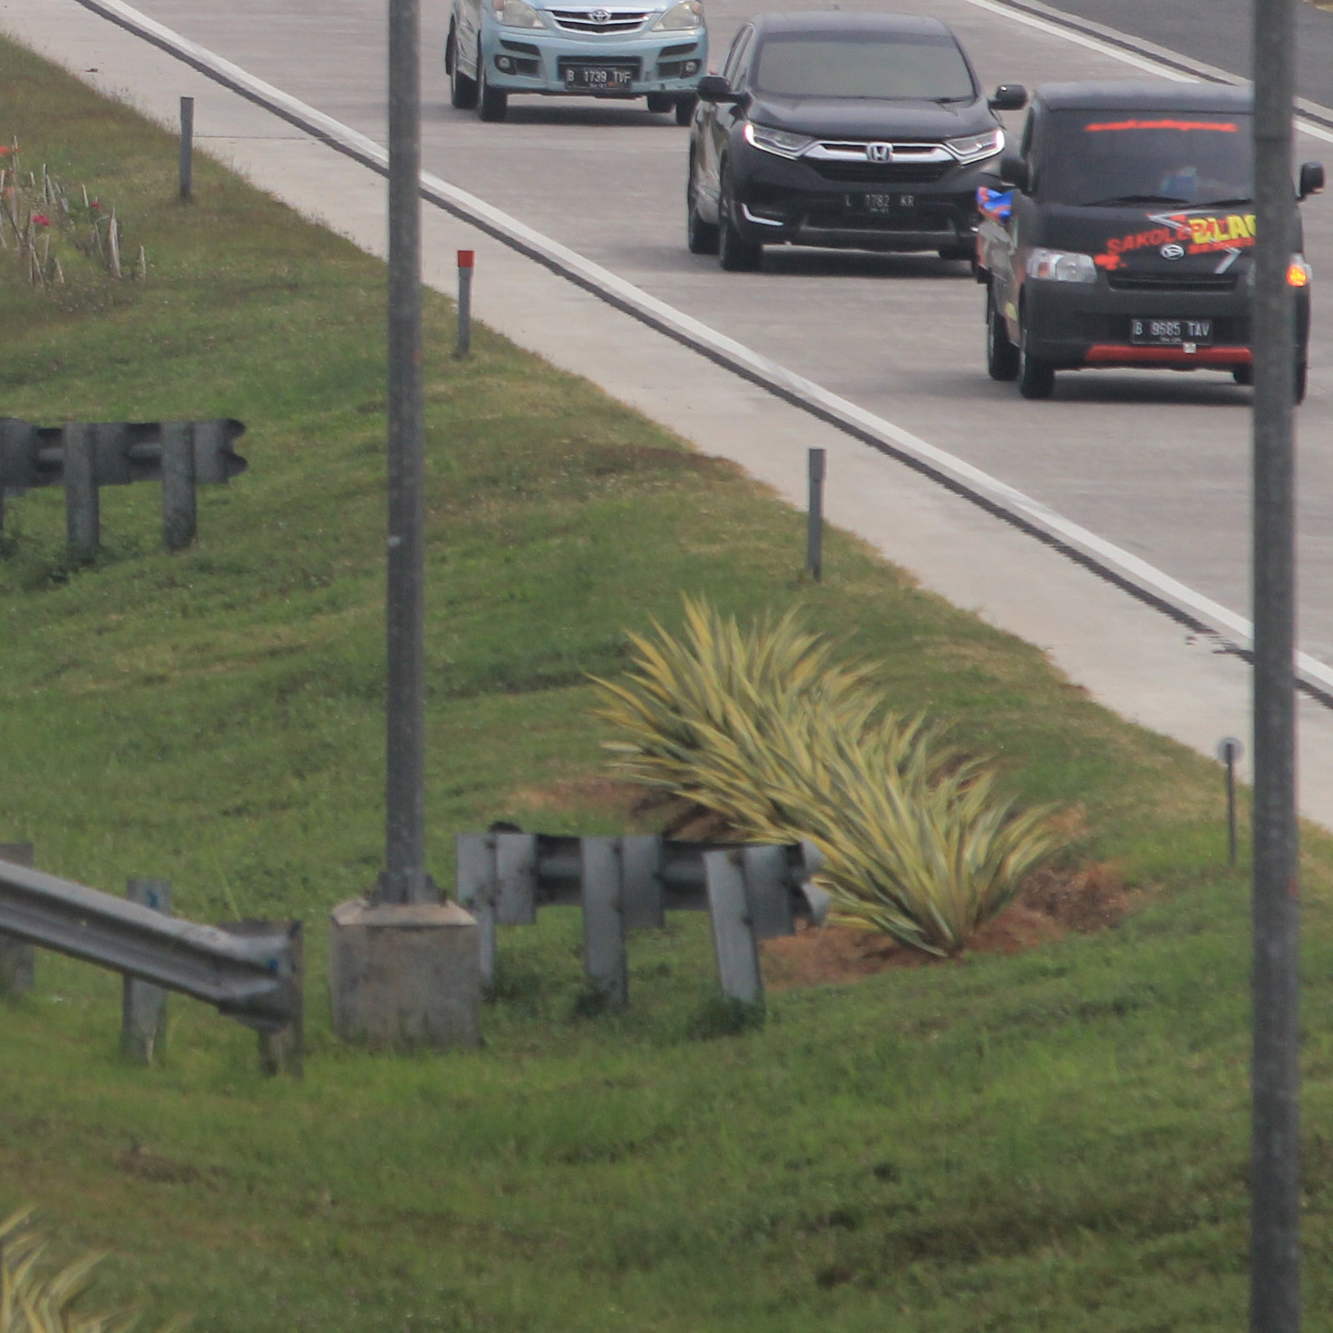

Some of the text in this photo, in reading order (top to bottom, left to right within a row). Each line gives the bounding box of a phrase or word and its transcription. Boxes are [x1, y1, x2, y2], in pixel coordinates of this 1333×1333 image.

[566, 69, 575, 82] B
[584, 70, 607, 83] 1739
[1134, 322, 1211, 337] B 9685 TAV
